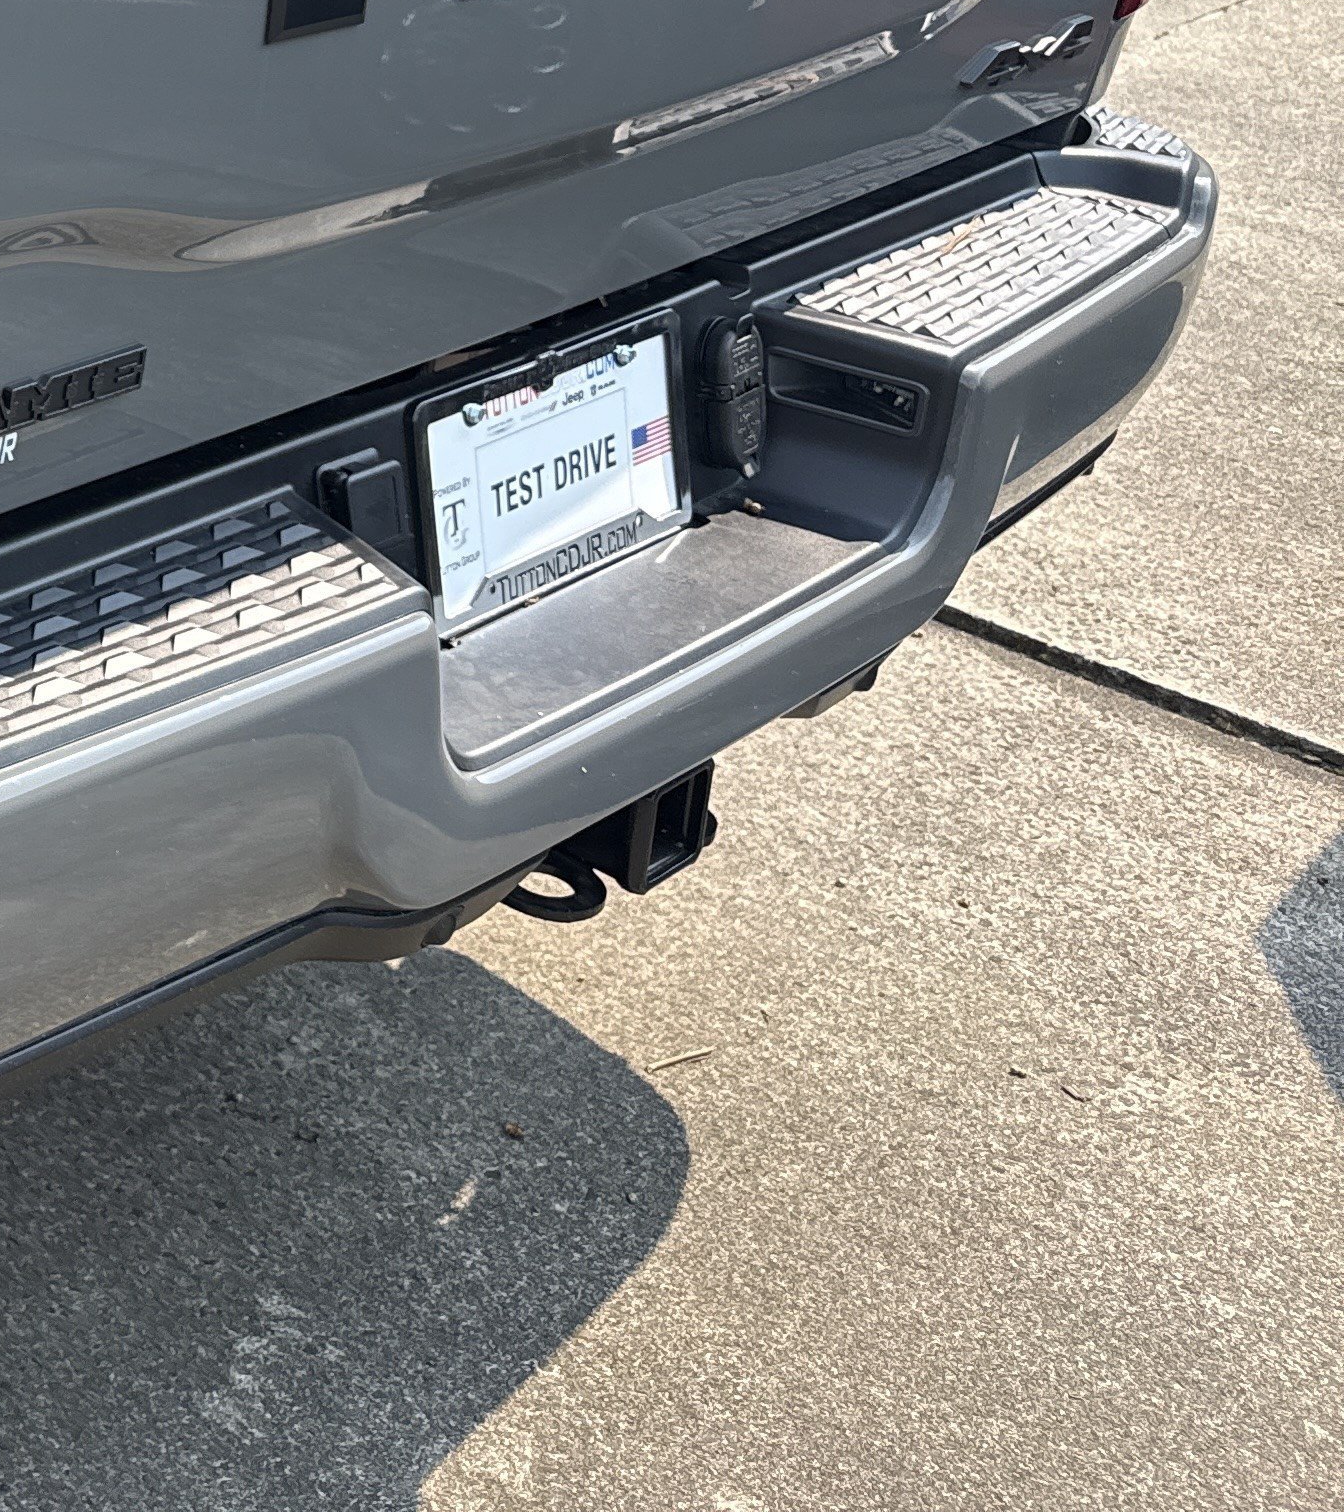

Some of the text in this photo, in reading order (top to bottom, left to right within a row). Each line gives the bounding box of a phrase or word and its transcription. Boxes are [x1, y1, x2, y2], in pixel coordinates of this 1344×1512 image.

[562, 389, 584, 407] Jeep
[490, 434, 617, 518] TEST DRIVE
